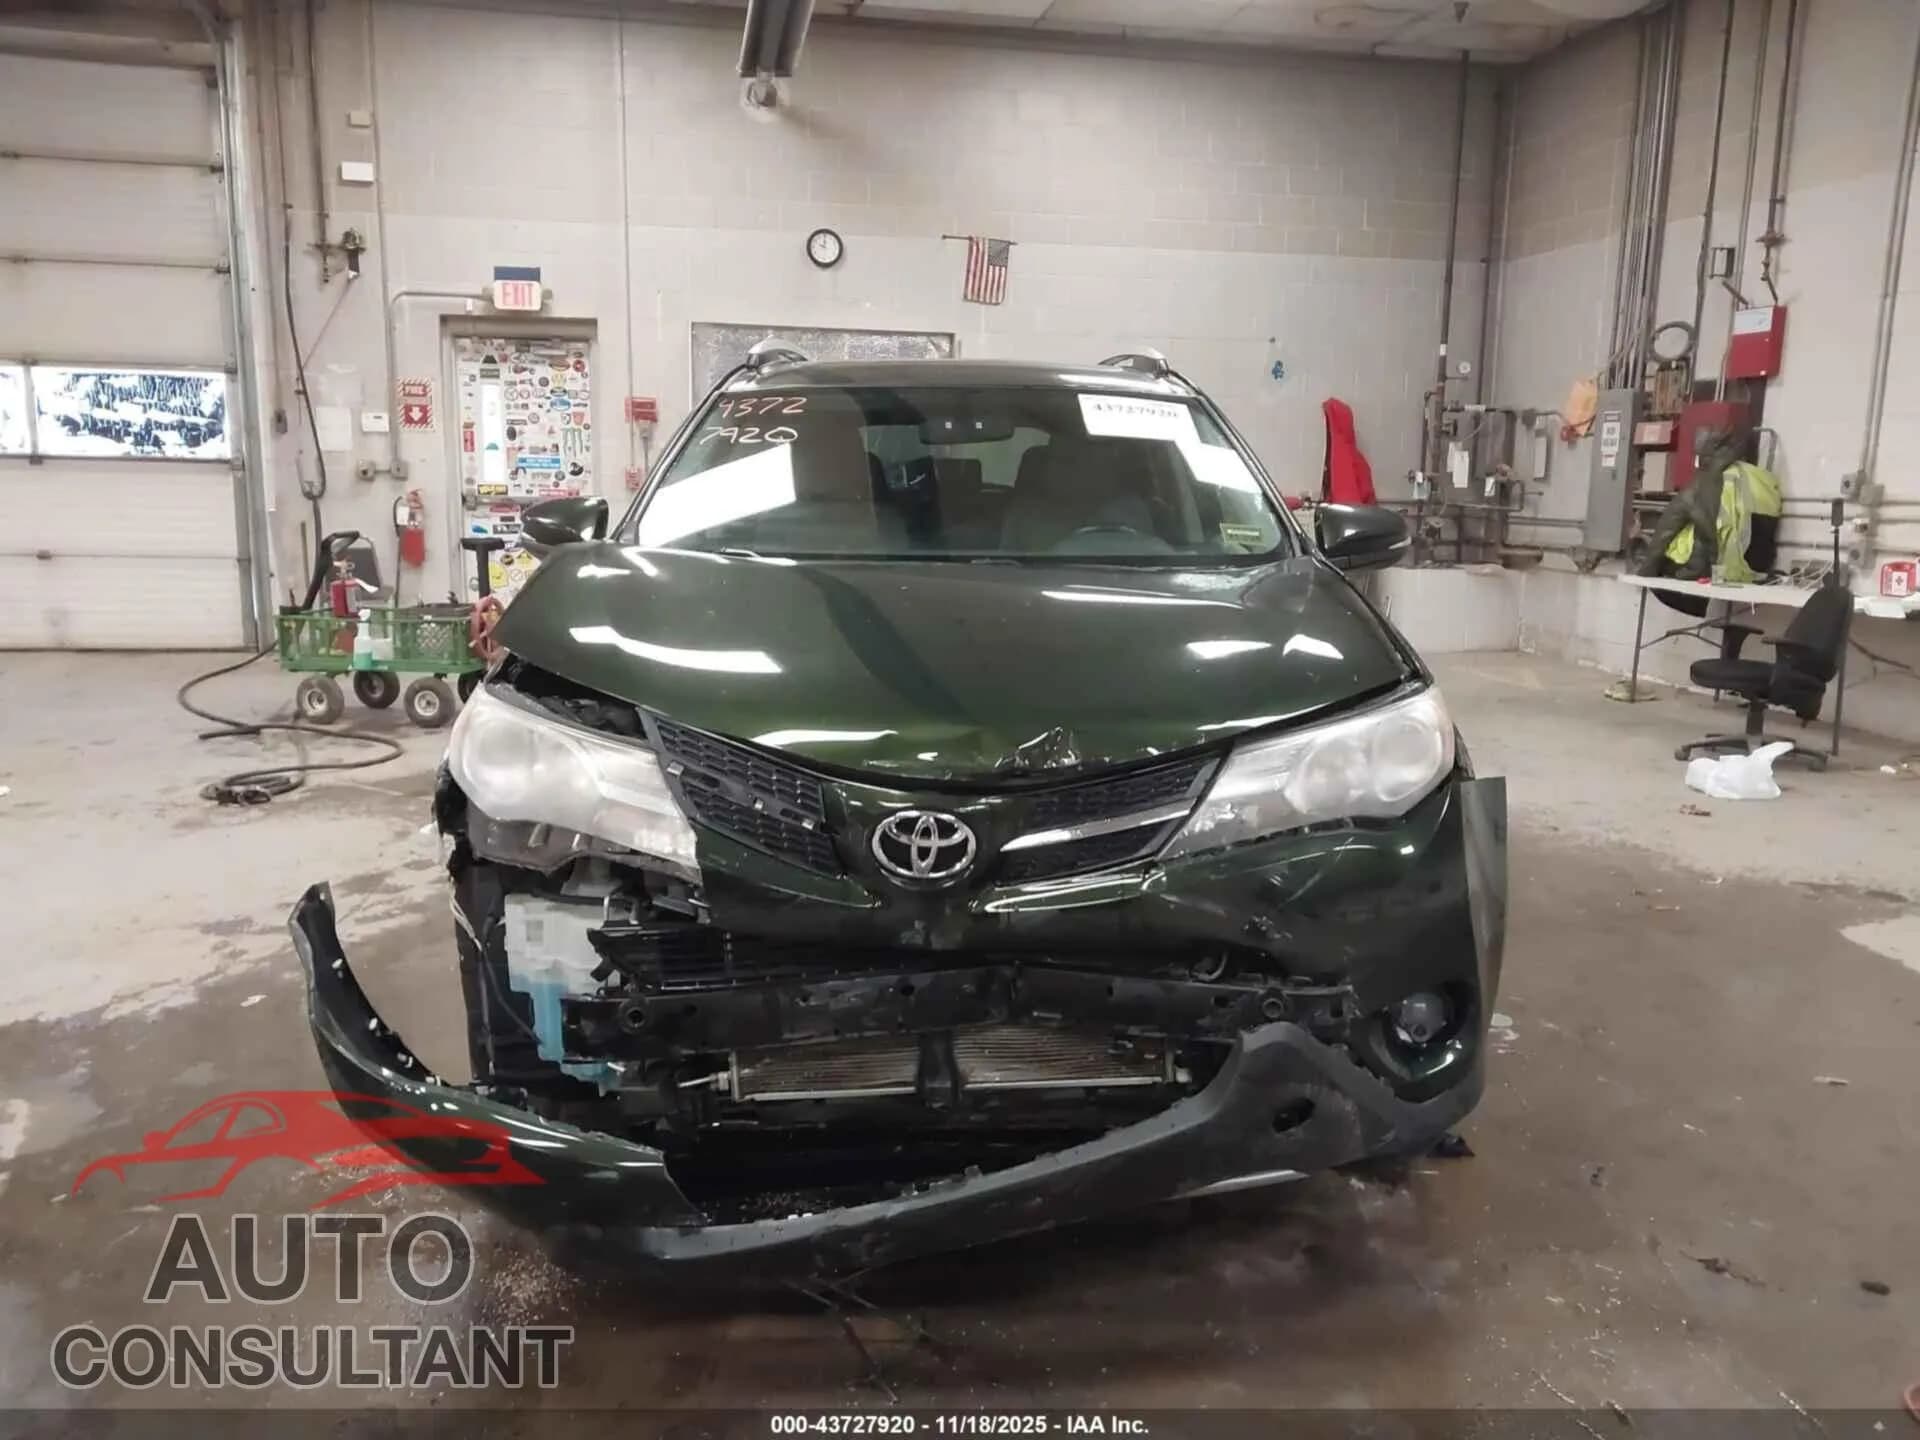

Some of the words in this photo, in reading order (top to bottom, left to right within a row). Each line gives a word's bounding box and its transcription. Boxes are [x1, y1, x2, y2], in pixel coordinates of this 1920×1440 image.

[502, 282, 533, 306] EXIT
[719, 397, 807, 418] 4372
[699, 426, 798, 444] 7920
